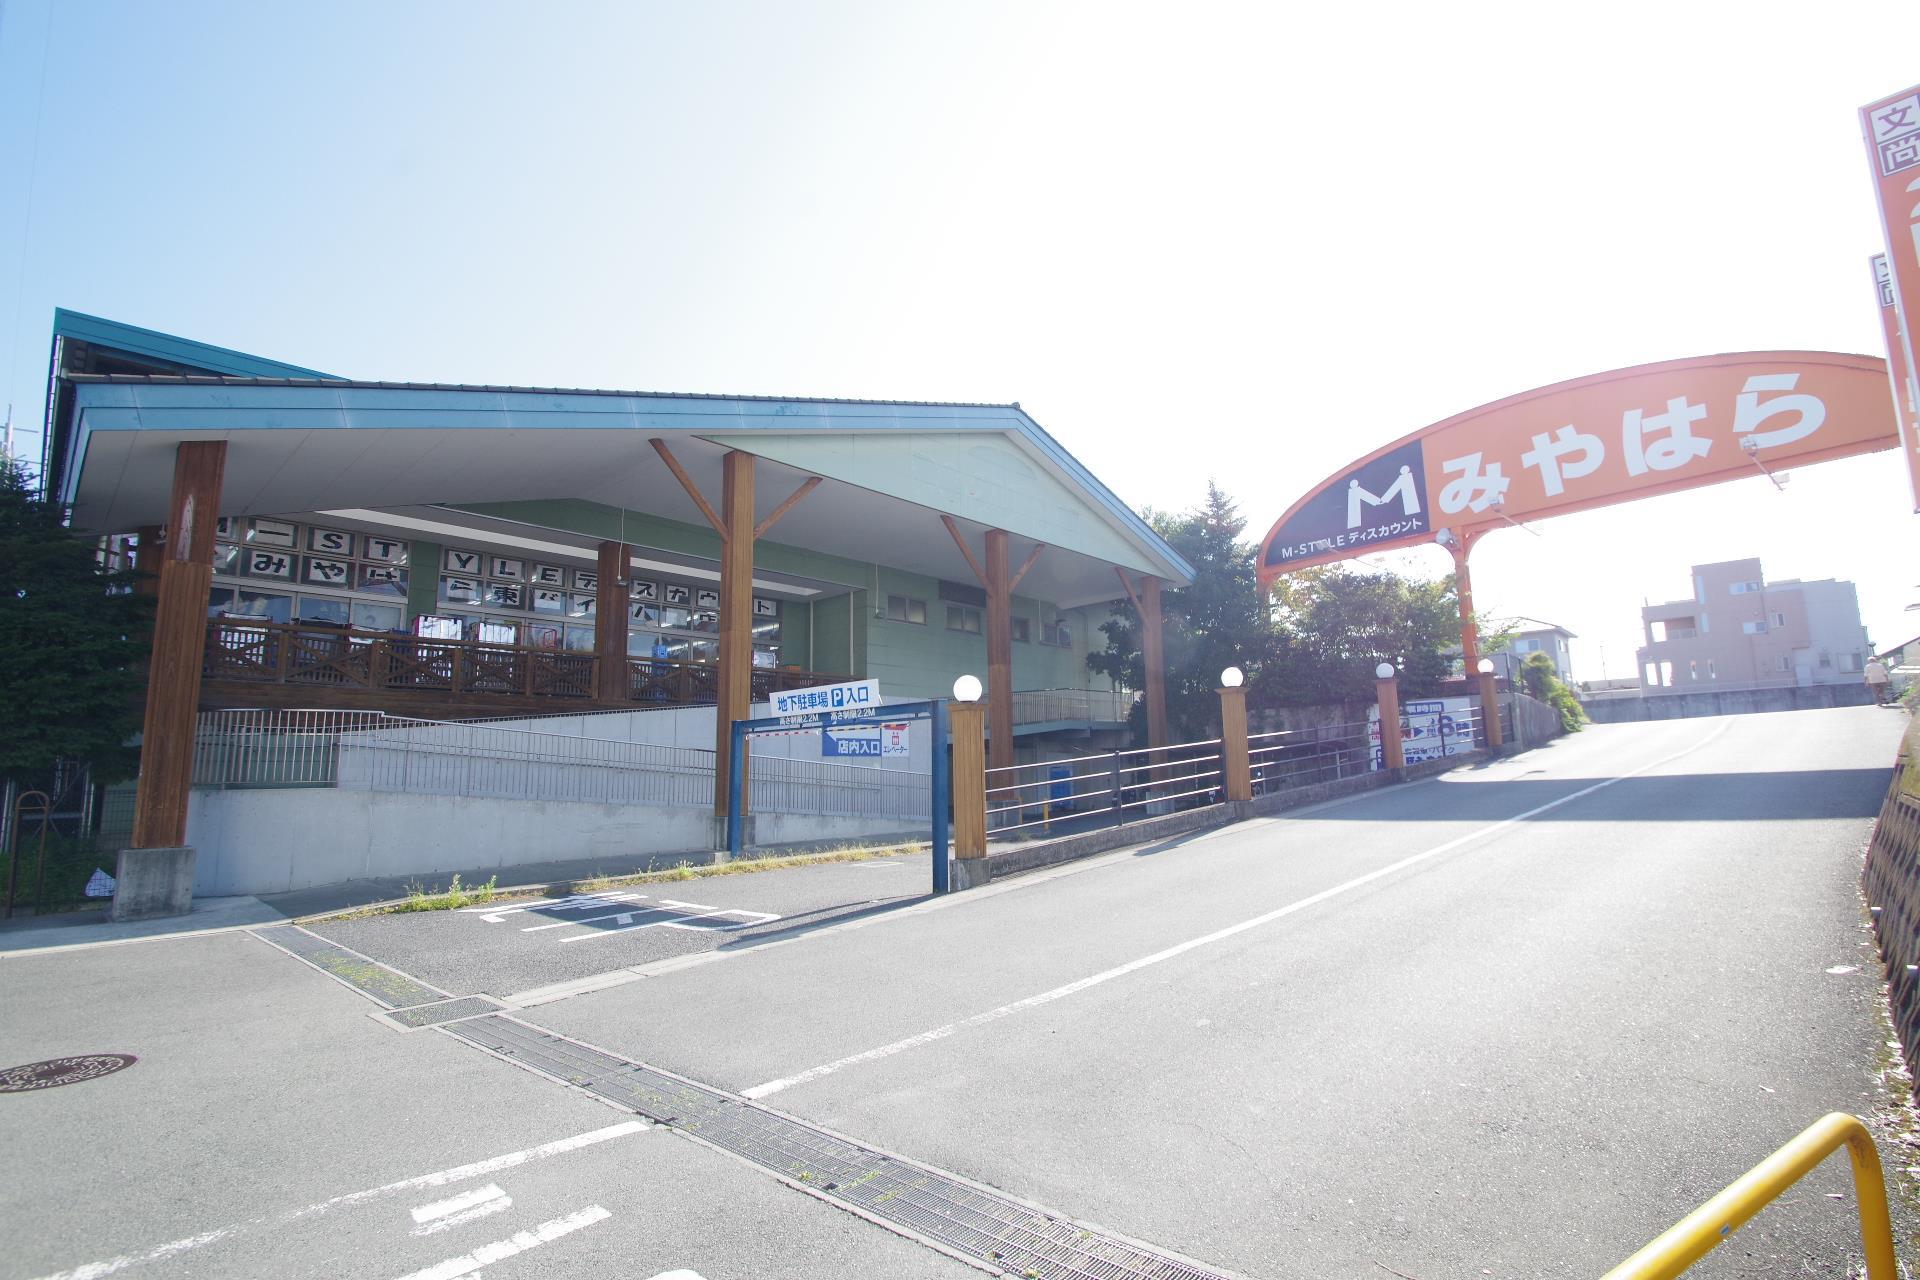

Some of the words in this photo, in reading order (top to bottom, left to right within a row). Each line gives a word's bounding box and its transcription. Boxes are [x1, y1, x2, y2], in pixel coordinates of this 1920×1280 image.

[1878, 105, 1915, 136] 文
[1438, 374, 1826, 516] みやはら
[1282, 534, 1345, 559] M-STLE
[1349, 518, 1422, 544] ディスカウント
[778, 692, 828, 712] 地下駐車場
[847, 687, 869, 704] 入口
[838, 740, 880, 754] 店内入口
